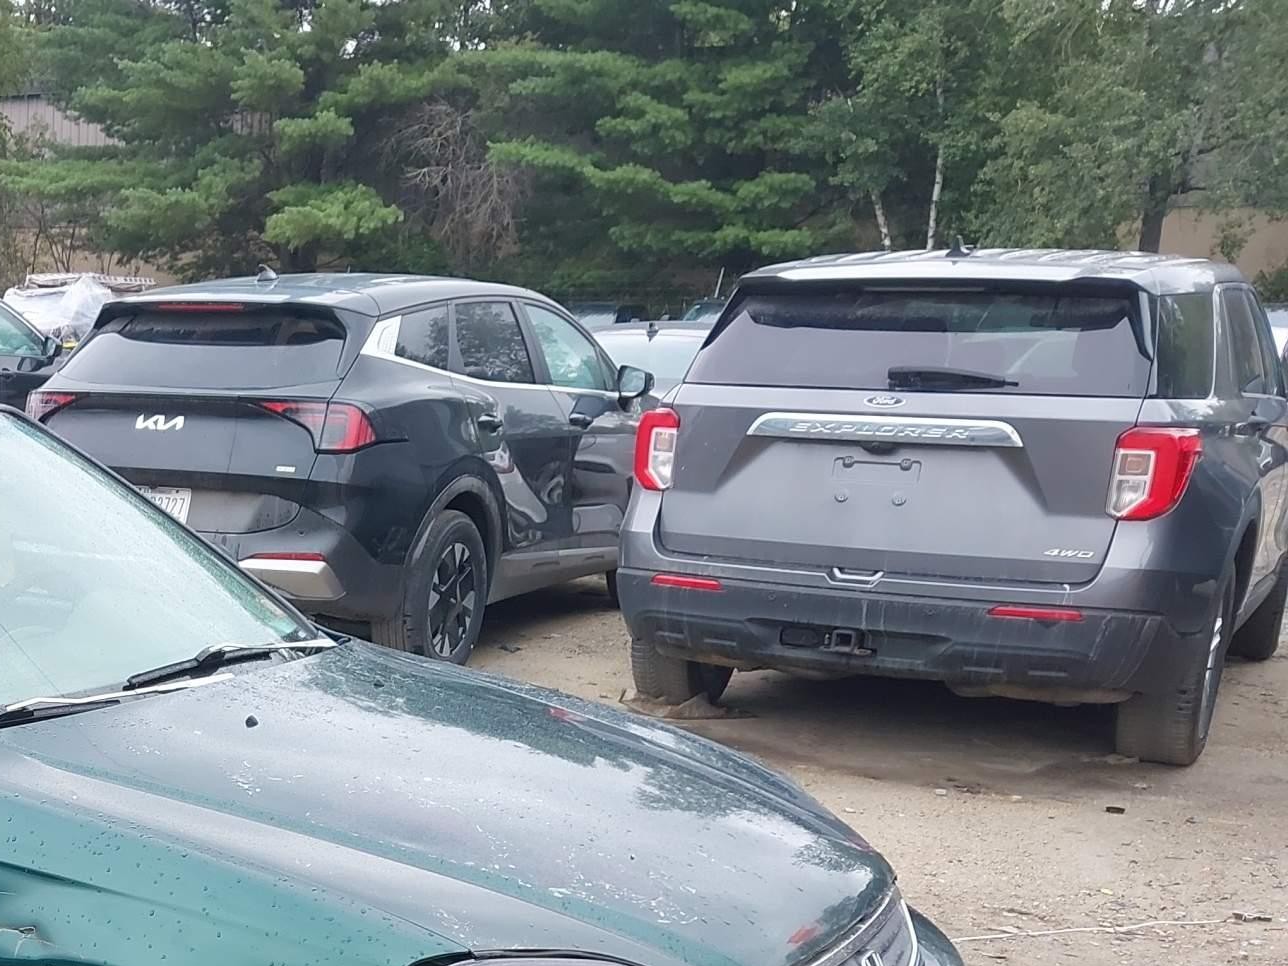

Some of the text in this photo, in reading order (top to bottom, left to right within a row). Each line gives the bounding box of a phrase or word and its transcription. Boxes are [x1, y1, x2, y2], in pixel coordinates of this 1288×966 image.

[135, 413, 185, 431] KIA
[789, 421, 969, 439] EXPLORER
[1043, 548, 1095, 558] 4WD
